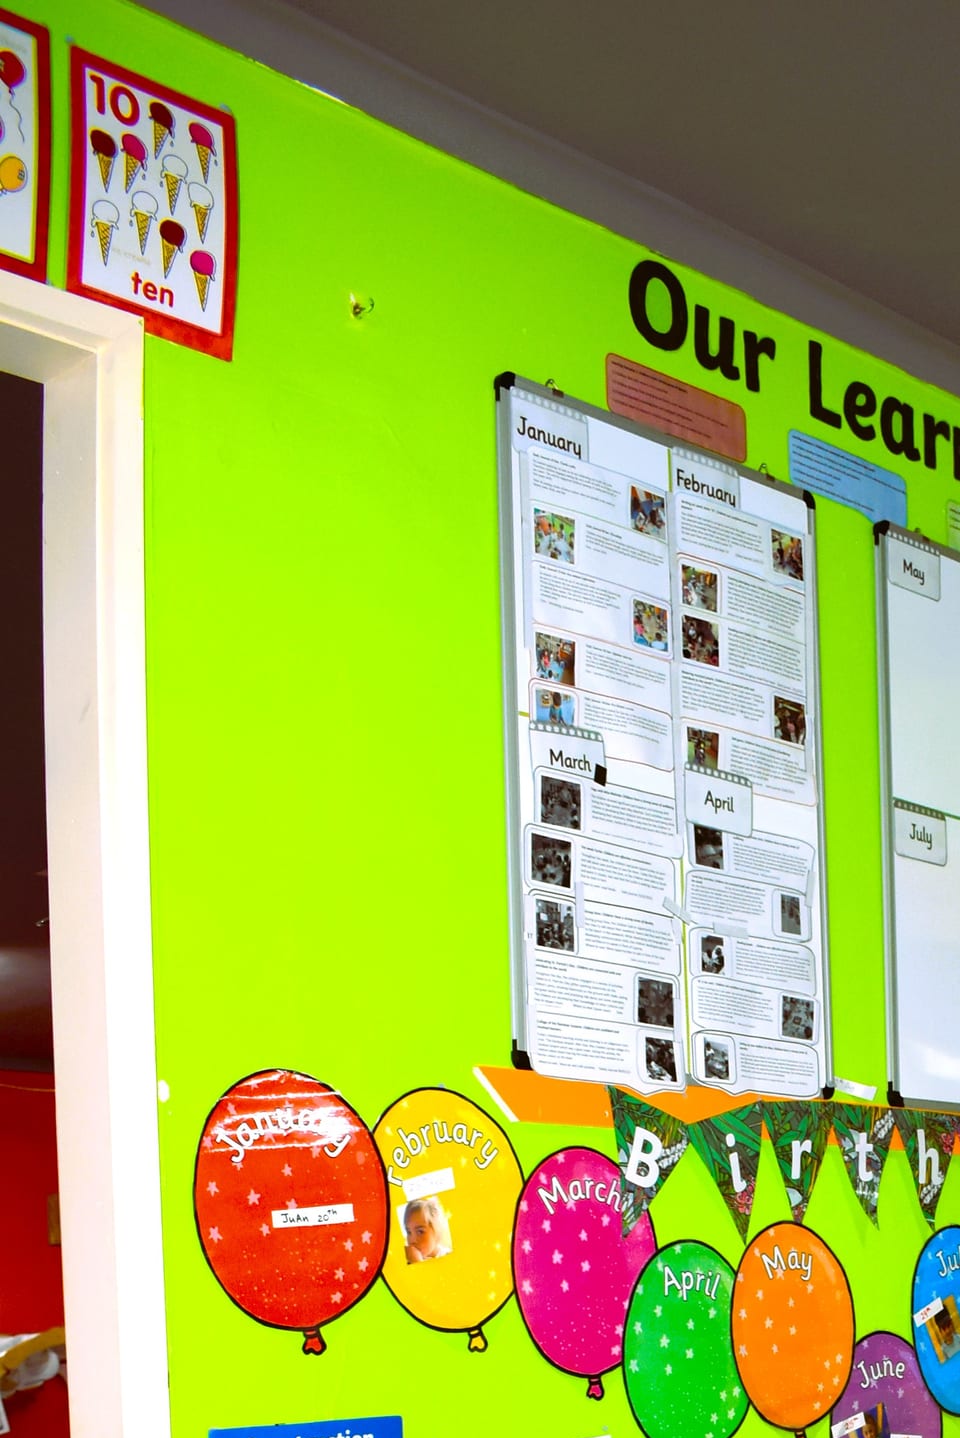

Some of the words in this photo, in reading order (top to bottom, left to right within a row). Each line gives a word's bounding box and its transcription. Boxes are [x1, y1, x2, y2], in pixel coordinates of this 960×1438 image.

[89, 72, 140, 126] 10
[131, 272, 174, 307] ten
[629, 259, 776, 393] Our
[517, 416, 581, 460] January
[676, 468, 737, 508] February
[903, 559, 925, 585] May
[549, 748, 592, 772] March
[704, 790, 735, 814] April
[909, 823, 933, 850] July
[215, 1106, 352, 1163] Januay
[537, 1175, 621, 1215] March
[761, 1245, 813, 1281] May
[663, 1265, 721, 1301] April
[857, 1357, 905, 1390] June
